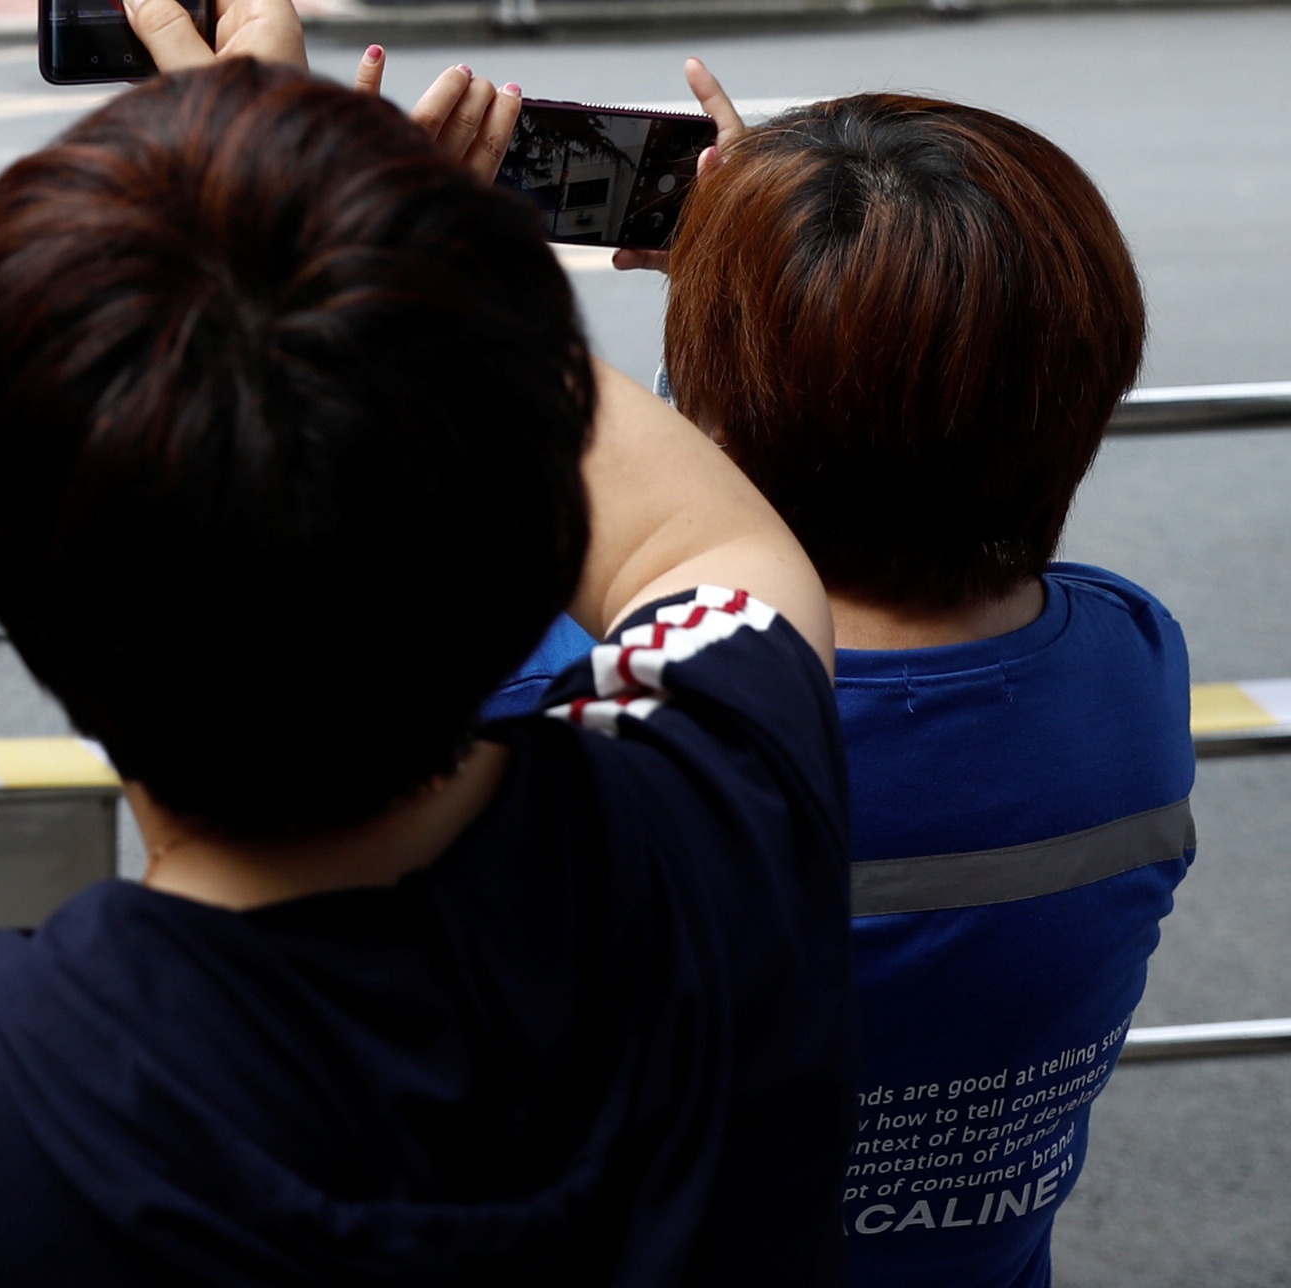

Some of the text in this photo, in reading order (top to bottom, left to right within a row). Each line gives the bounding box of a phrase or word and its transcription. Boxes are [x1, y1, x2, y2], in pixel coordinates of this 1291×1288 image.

[876, 1106, 929, 1132] how
[935, 1106, 959, 1125] to
[967, 1097, 1004, 1121] tell
[1011, 1059, 1110, 1112] consumers
[902, 1080, 940, 1102] are
[947, 1068, 1008, 1100] good
[1015, 1065, 1036, 1087] at
[1041, 1042, 1098, 1078] telling
[842, 1121, 1076, 1204] pt of consumer brand
[852, 1133, 921, 1155] ntext
[928, 1127, 955, 1148] of
[961, 1112, 1028, 1145] brand
[973, 1142, 1000, 1164] of
[1003, 1118, 1061, 1157] brand
[844, 1152, 1074, 1237] CALINE”
